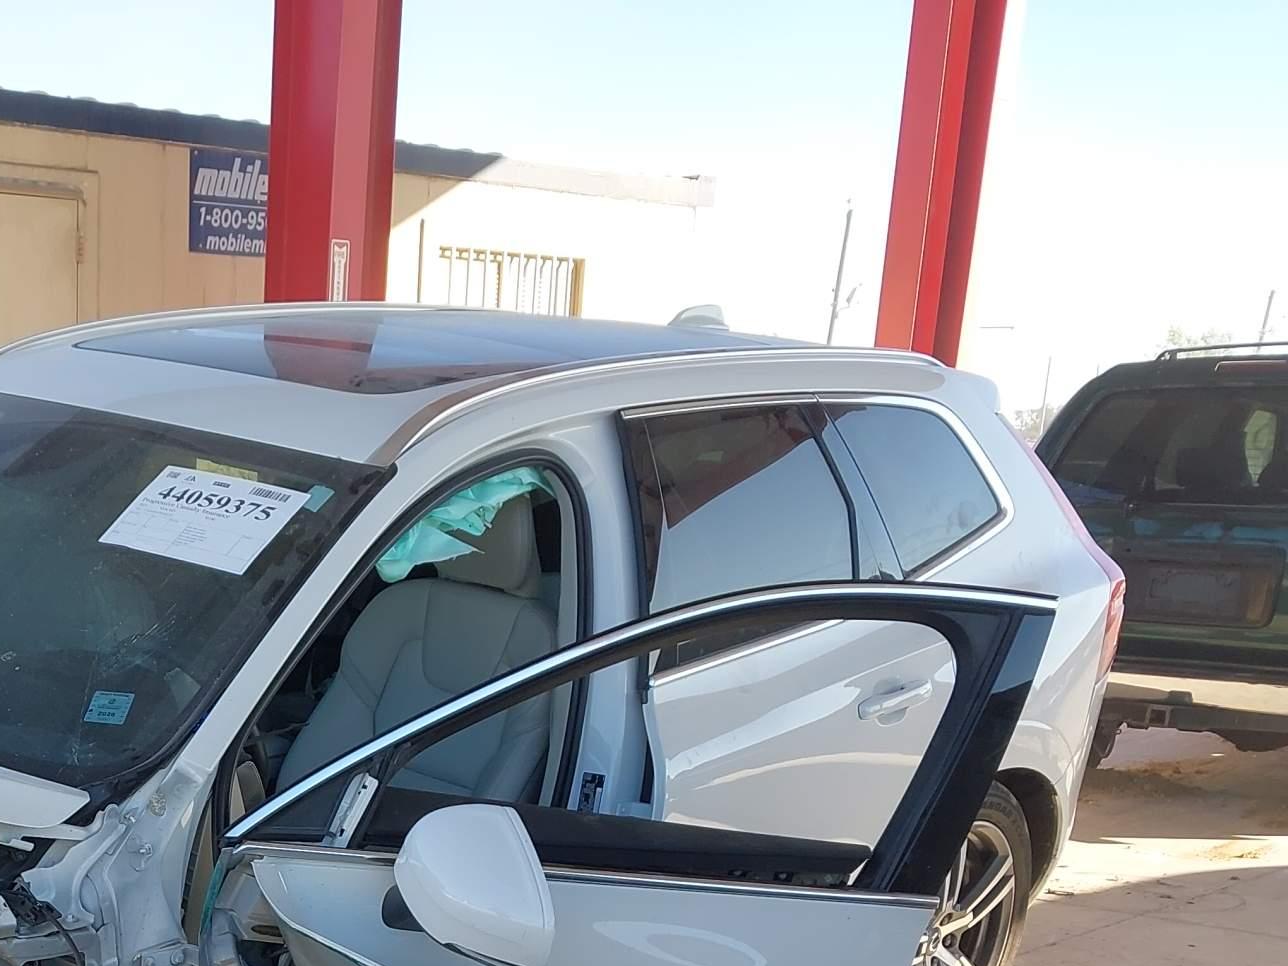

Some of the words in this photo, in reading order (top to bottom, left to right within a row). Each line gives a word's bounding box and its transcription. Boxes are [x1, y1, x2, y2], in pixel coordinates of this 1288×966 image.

[193, 157, 268, 201] mobile
[199, 206, 268, 231] 1-800-95
[206, 233, 267, 252] mobilem
[158, 485, 276, 520] 44059375
